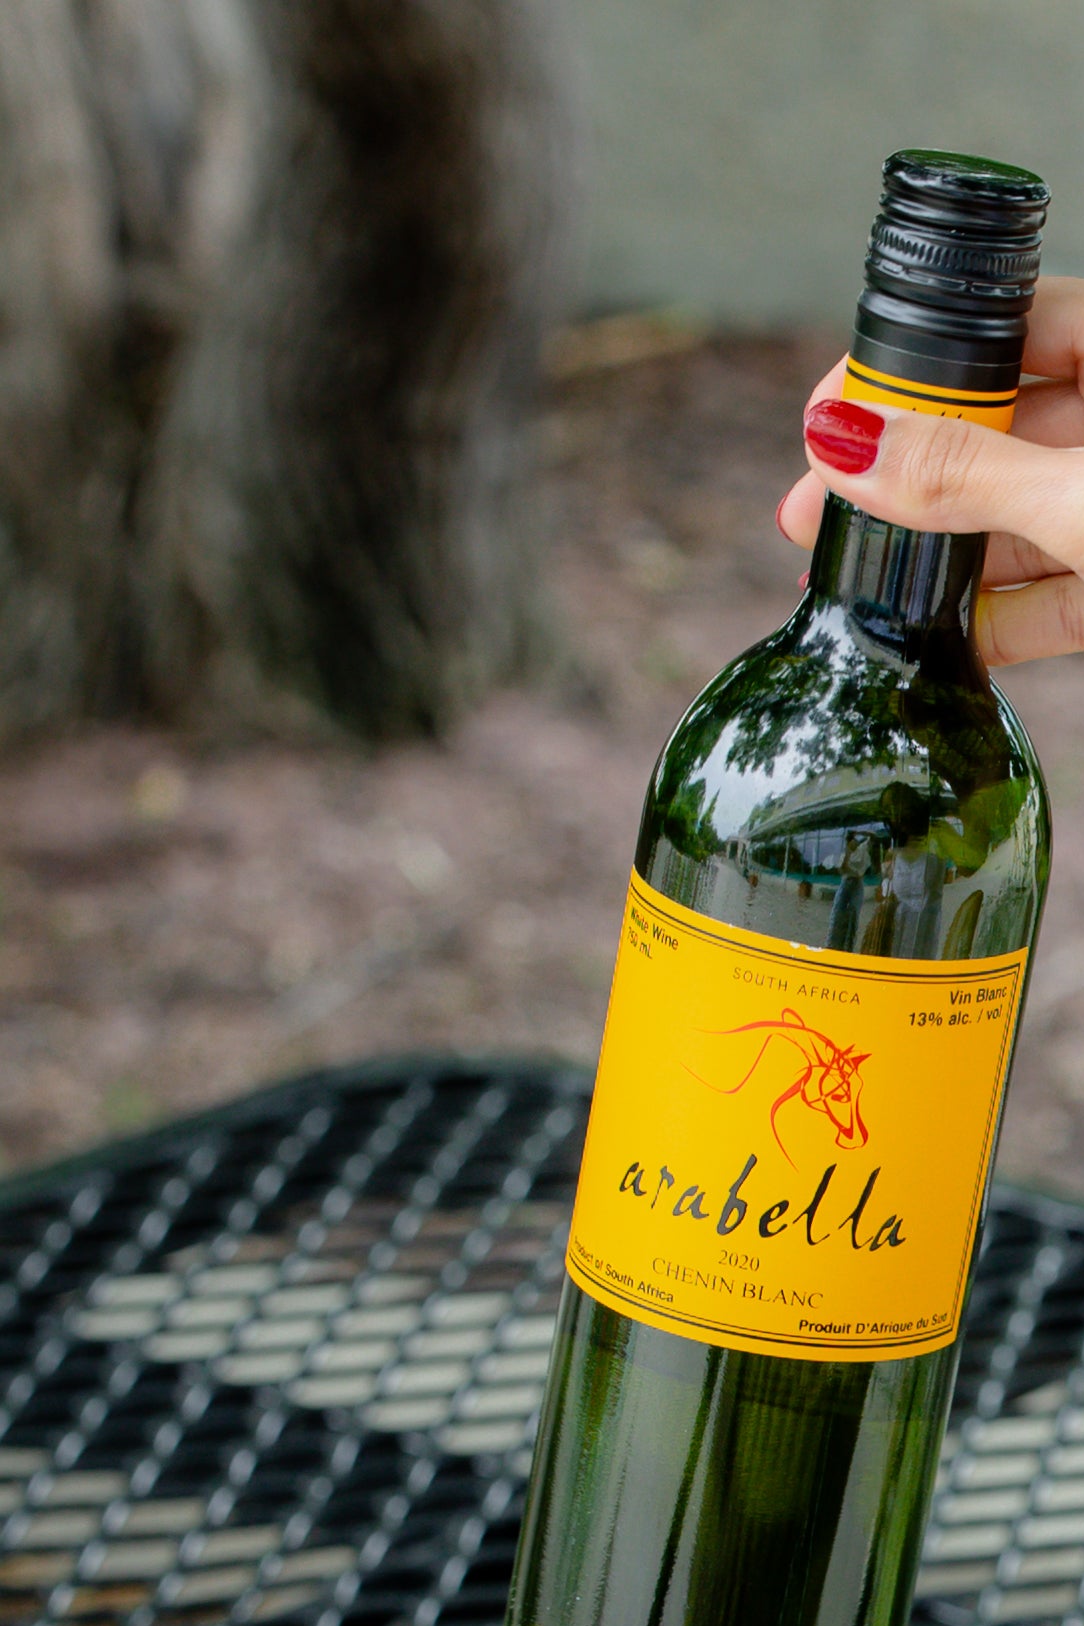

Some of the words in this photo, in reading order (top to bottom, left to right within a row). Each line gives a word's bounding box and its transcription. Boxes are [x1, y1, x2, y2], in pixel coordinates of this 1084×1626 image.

[652, 922, 679, 951] Wine
[733, 966, 788, 992] SOUTH
[796, 984, 861, 1005] AFRICA
[950, 989, 971, 1005] Vin
[976, 986, 1007, 1003] Blanc
[909, 1012, 943, 1027] 13%
[948, 1010, 972, 1026] alc.
[986, 1003, 1003, 1020] vol
[619, 1153, 906, 1251] arabella
[718, 1249, 760, 1272] 2020
[605, 1263, 634, 1288] South
[637, 1281, 674, 1303] Africa
[652, 1257, 735, 1295] CHENIN
[742, 1282, 823, 1309] BLANC
[799, 1319, 851, 1334] Produit
[855, 1320, 912, 1335] D'Afrique
[916, 1317, 929, 1330] du
[931, 1312, 948, 1326] Sud
